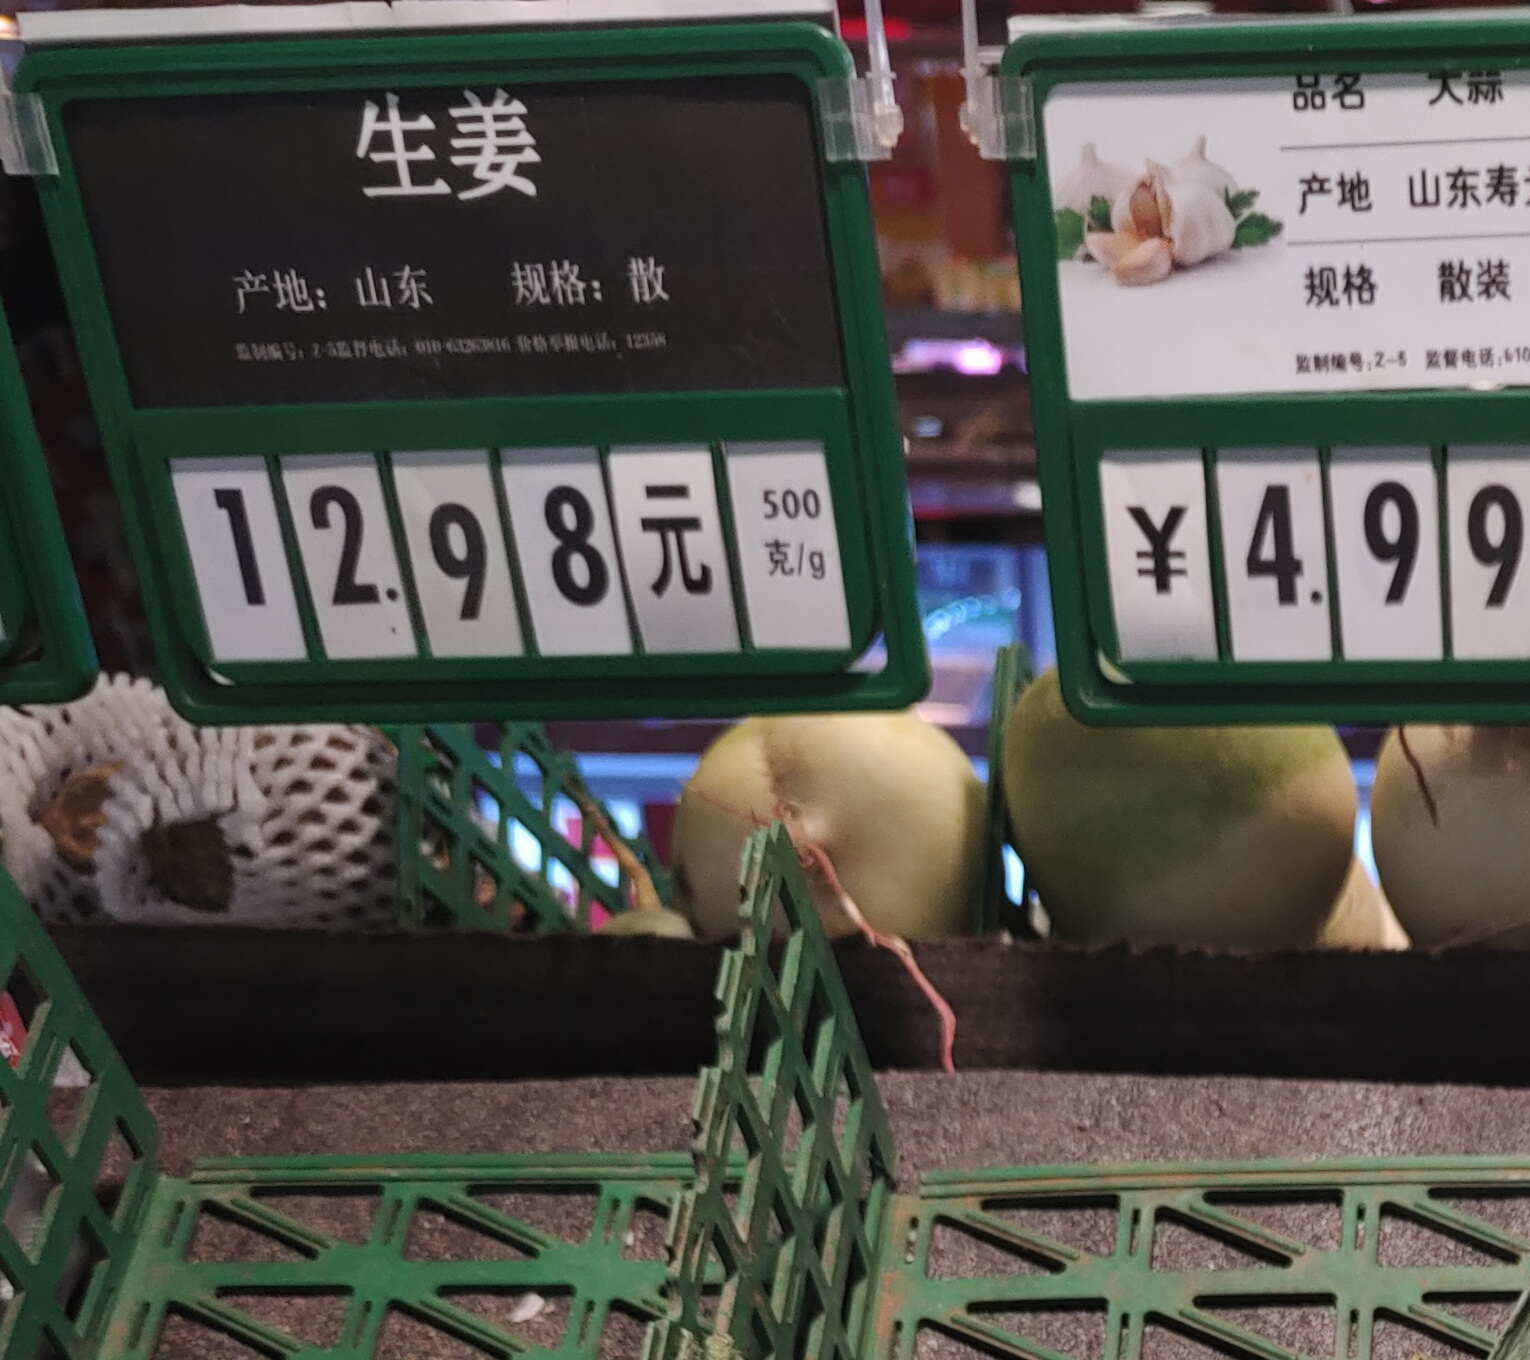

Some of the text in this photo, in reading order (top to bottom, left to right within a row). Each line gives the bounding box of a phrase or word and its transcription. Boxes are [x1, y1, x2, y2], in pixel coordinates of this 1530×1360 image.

[1293, 73, 1366, 112] 品名
[1428, 70, 1505, 106] 大蒜
[356, 89, 543, 201] 生姜
[1298, 170, 1374, 216] 产地
[1304, 263, 1378, 308] 规格
[1437, 257, 1513, 304] 散装
[762, 488, 823, 521] 500
[764, 538, 828, 580] 克/g
